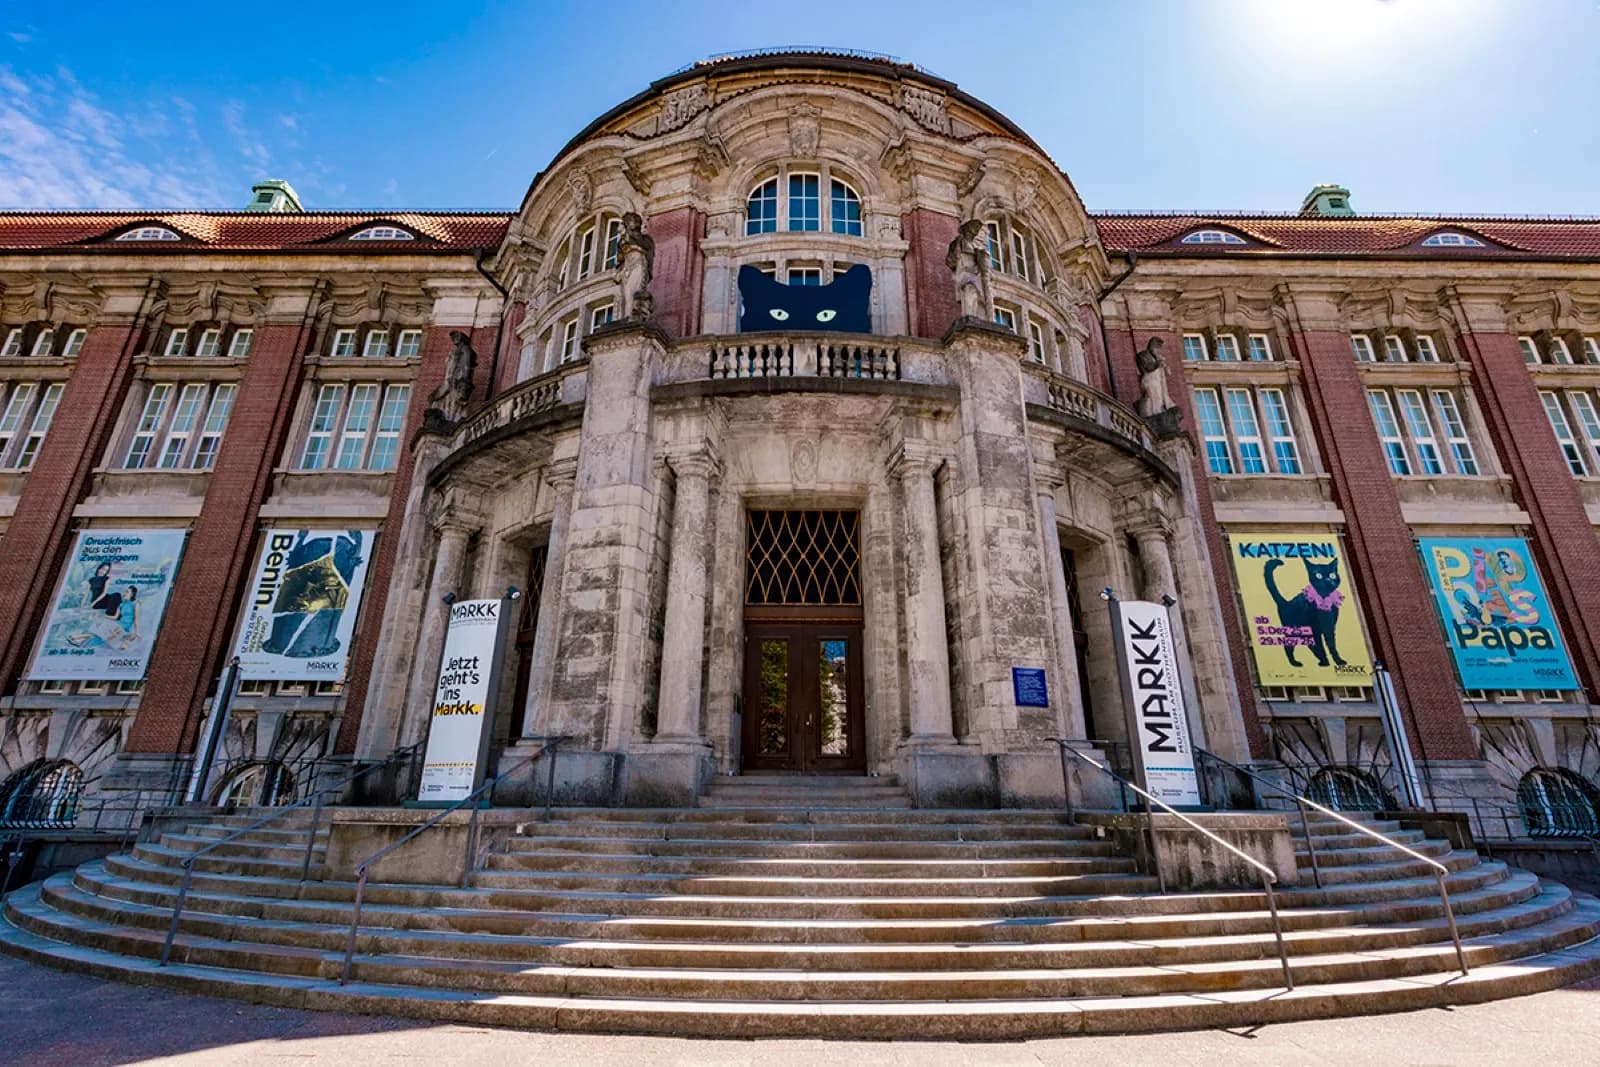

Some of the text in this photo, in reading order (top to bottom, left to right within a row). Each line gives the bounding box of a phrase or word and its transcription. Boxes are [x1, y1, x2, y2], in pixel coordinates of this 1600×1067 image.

[82, 545, 121, 554] aus den
[85, 537, 142, 546] Druckfrisch
[79, 554, 139, 562] Zwanzigern
[1238, 542, 1336, 558] KATZEN!
[253, 534, 295, 612] Benin.
[451, 603, 498, 620] MARKK
[1254, 616, 1269, 624] ab
[1453, 619, 1556, 656] Papa
[109, 658, 141, 667] MARKK
[306, 661, 339, 670] MARKK
[445, 656, 480, 673] Jetzt
[443, 685, 461, 701] ins
[1128, 617, 1177, 753] MARKK
[1168, 690, 1176, 705] AM
[435, 700, 480, 716] Markk.
[1171, 707, 1185, 754] MUSEUM
